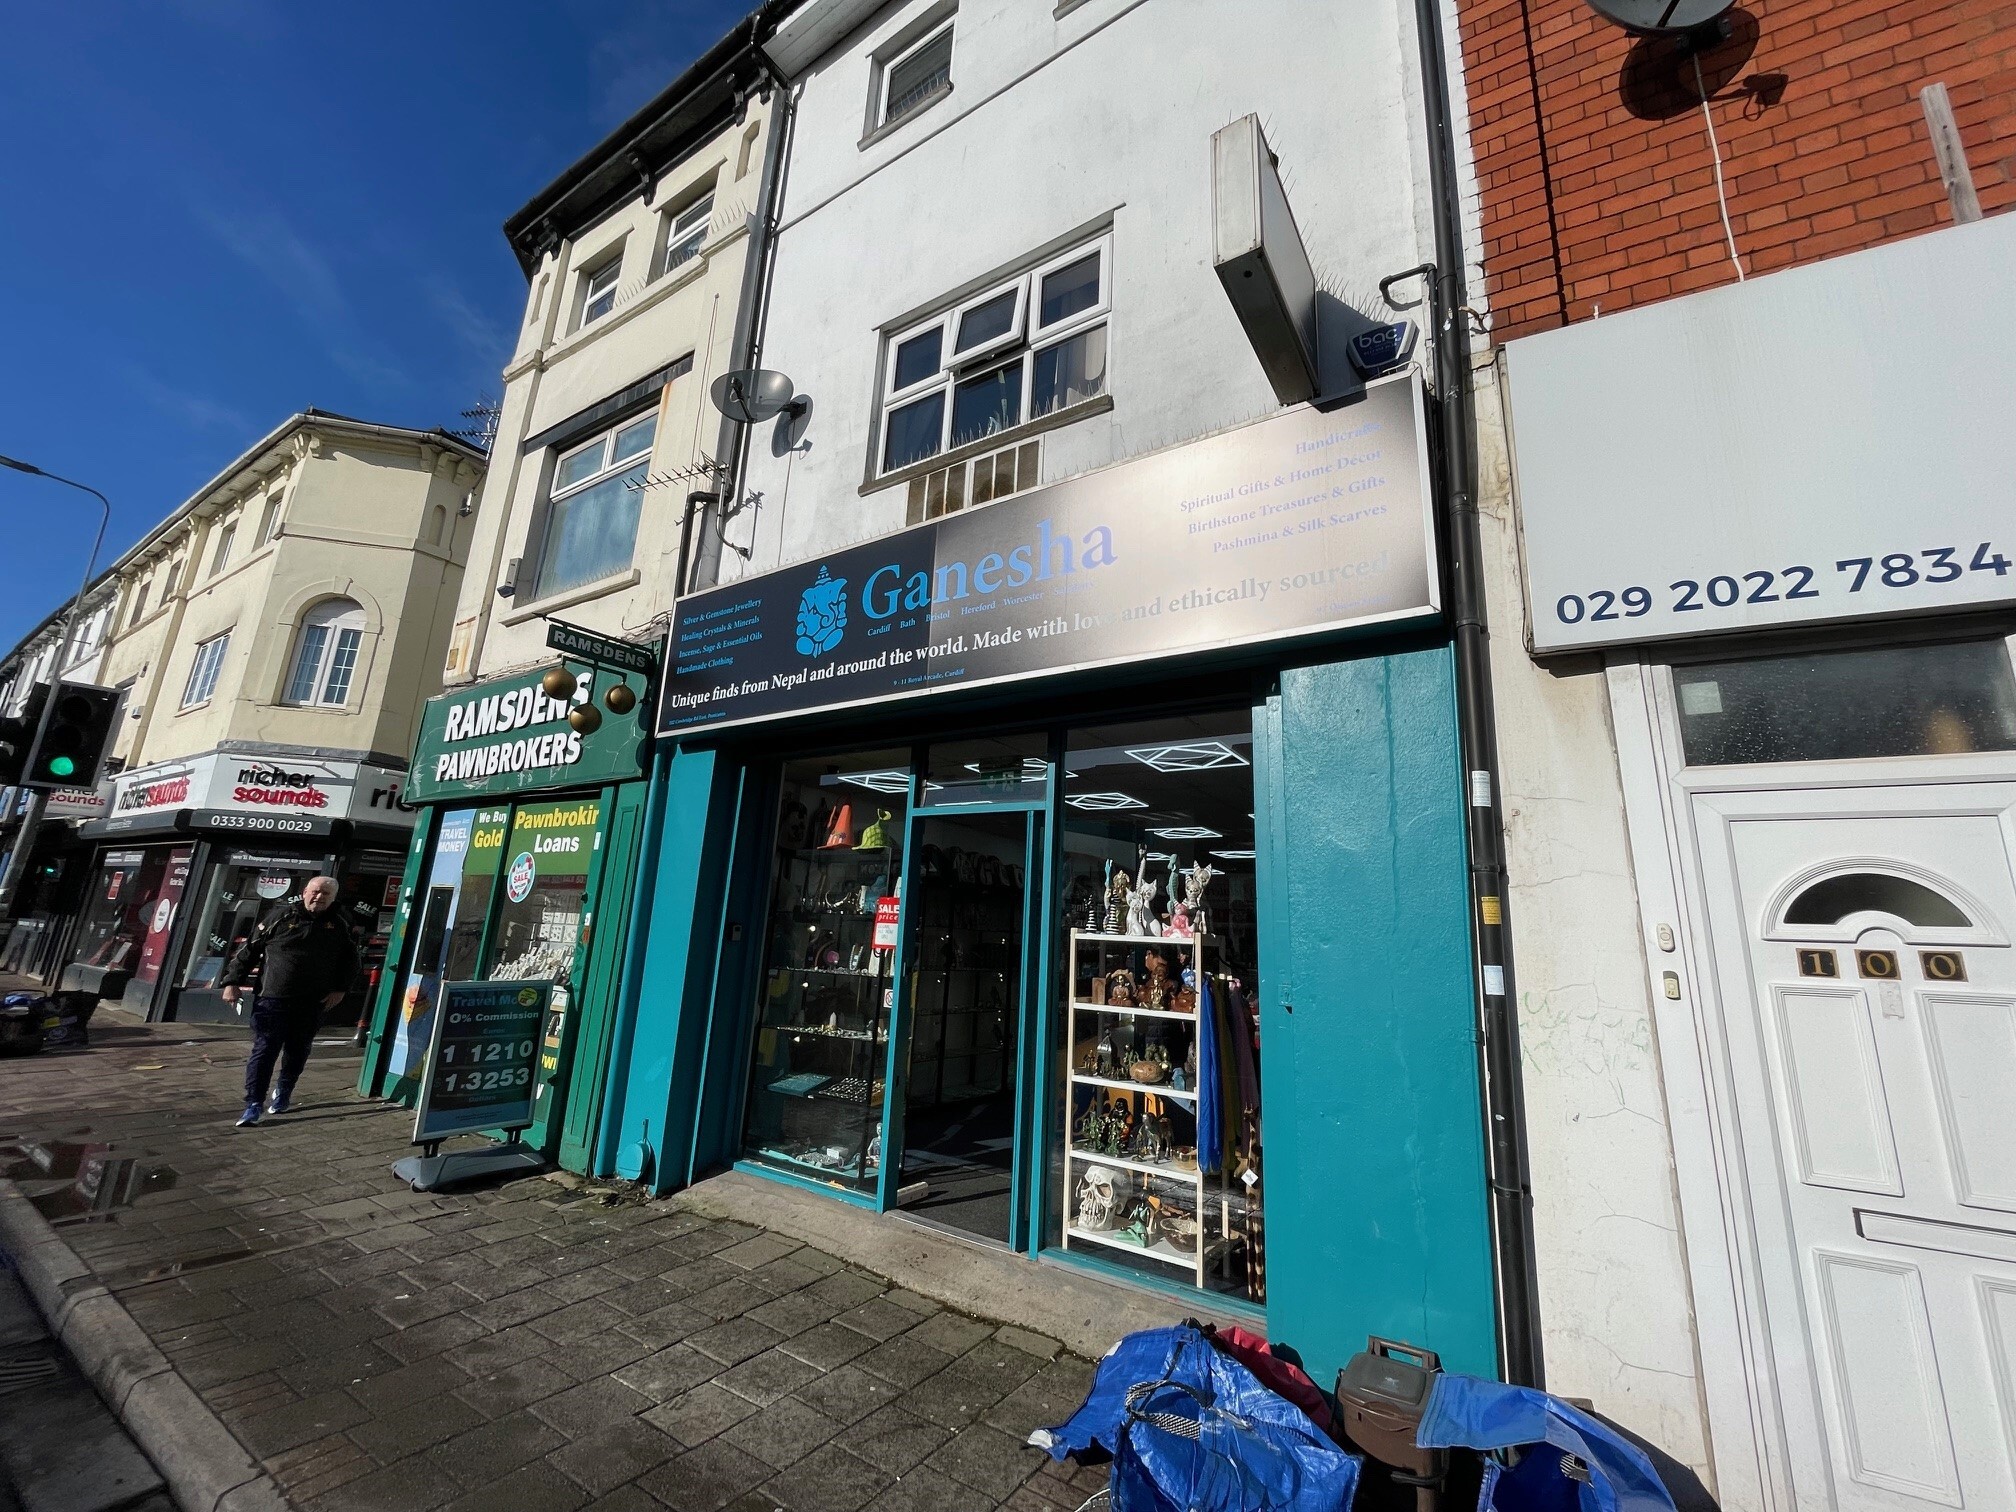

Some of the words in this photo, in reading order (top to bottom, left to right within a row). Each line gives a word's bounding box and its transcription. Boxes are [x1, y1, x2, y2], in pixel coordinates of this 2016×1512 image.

[1180, 488, 1234, 513] Spiritual
[1238, 479, 1270, 496] Gifts
[1274, 475, 1285, 487] &
[1290, 464, 1333, 483] Home
[1337, 450, 1382, 470] Decor
[1188, 511, 1256, 534] Birthstone
[1260, 492, 1328, 517] Treasures
[1332, 486, 1344, 498] &
[1349, 476, 1386, 493] Gifts
[1214, 529, 1278, 554] Pashmina
[1282, 526, 1294, 537] &
[1298, 518, 1326, 534] Silk
[1330, 505, 1388, 527] Scarves
[861, 518, 1118, 620] Ganesha
[1556, 586, 1653, 624] 029
[1669, 564, 1820, 614] 2022
[1836, 542, 2012, 592] 7834
[683, 616, 700, 626] Silver
[706, 606, 734, 620] Gemstone
[735, 599, 762, 614] Jewellery
[868, 624, 892, 636] Cardiff
[900, 618, 916, 629] Bath
[926, 610, 950, 622] Bristol
[961, 600, 996, 616] Hereford
[1003, 591, 1044, 606] Worcester
[672, 692, 710, 708] Unique
[712, 683, 740, 700] finds
[741, 680, 769, 696] from
[771, 668, 808, 690] Nepal
[810, 665, 835, 686] and
[837, 654, 887, 678] around
[890, 644, 913, 666] the
[916, 636, 969, 661] world.
[972, 624, 1022, 650] Made
[1026, 616, 1070, 641] with
[1122, 596, 1162, 622] and
[1168, 577, 1271, 614] ethically
[1280, 550, 1390, 592] sourced
[681, 631, 702, 642] Healing
[704, 624, 726, 637] Crystals
[726, 622, 732, 630] &
[734, 616, 760, 629] Minerals
[554, 630, 646, 668] RAMSDENS
[702, 644, 716, 654] Sage
[716, 641, 722, 649] &
[723, 634, 749, 648] Essential
[750, 632, 763, 642] Oils
[676, 662, 708, 674] Handmade
[708, 656, 734, 668] Clothing
[944, 668, 966, 678] Cardiff
[444, 672, 592, 742] RAMSDENS
[435, 732, 583, 782] PAWNBROKERS
[237, 764, 314, 788] richer
[50, 793, 106, 807] sounds
[233, 784, 328, 808] sounds
[370, 784, 414, 814] ric
[211, 815, 244, 828] 0333
[248, 817, 274, 830] 900
[278, 818, 312, 832] 0029
[479, 812, 490, 824] We
[493, 811, 507, 824] Buy
[440, 828, 468, 840] TRAVEL
[474, 829, 504, 848] Gold
[534, 834, 580, 853] Loans
[438, 840, 466, 852] MONEY
[260, 876, 287, 886] SALE
[514, 872, 528, 884] SALE
[356, 901, 378, 914] SALE
[878, 904, 900, 914] SALE
[878, 914, 898, 922] price
[452, 995, 496, 1008] Travel
[450, 1013, 472, 1024] 0%
[476, 1010, 538, 1022] Commission
[446, 1067, 530, 1092] 1.3253
